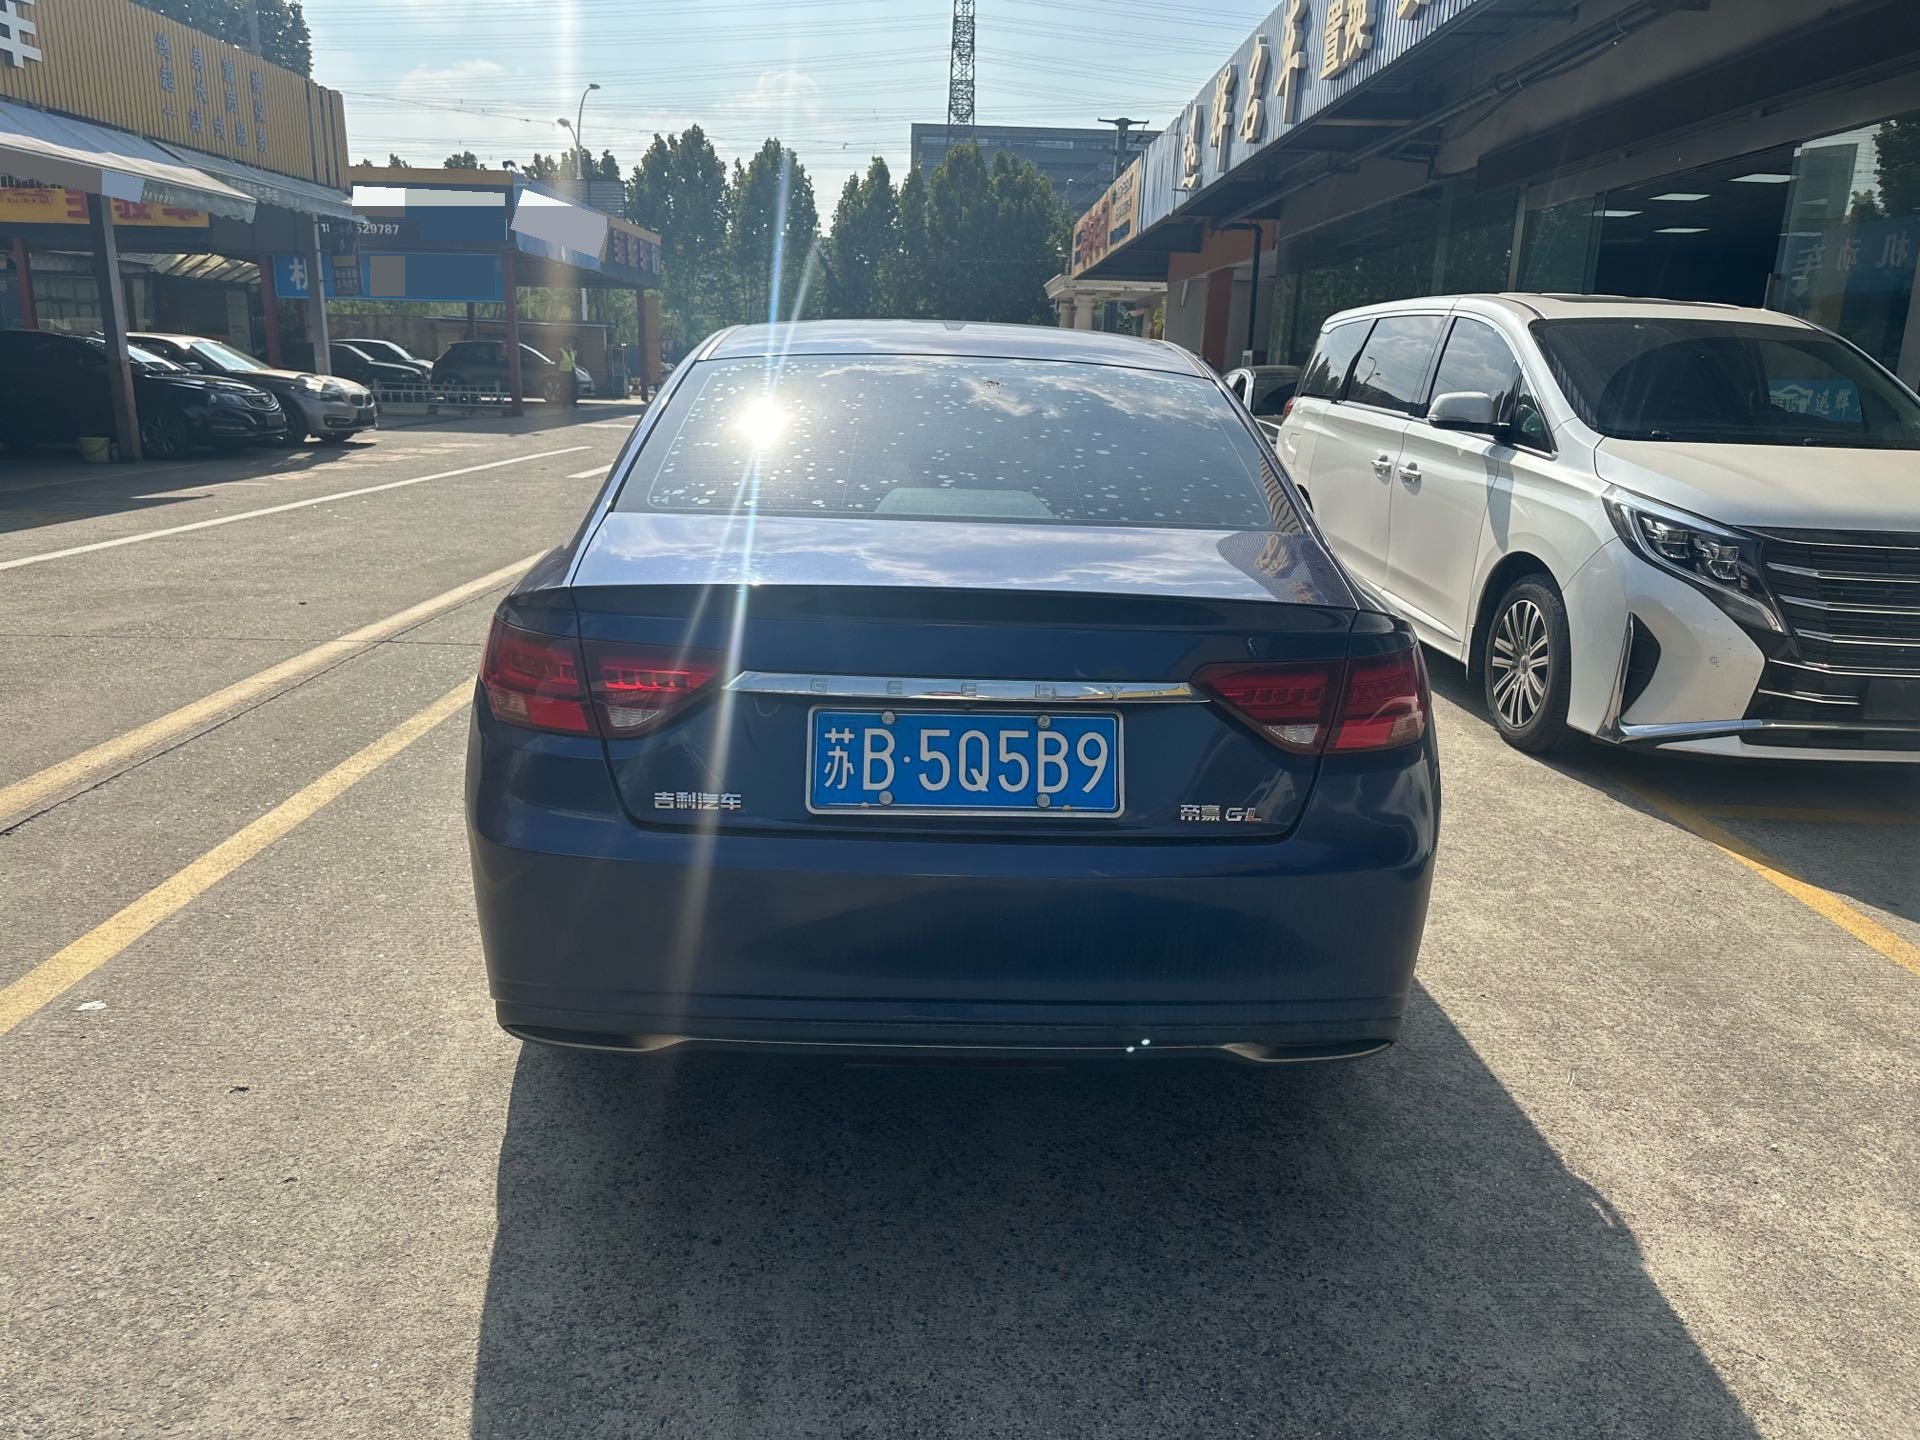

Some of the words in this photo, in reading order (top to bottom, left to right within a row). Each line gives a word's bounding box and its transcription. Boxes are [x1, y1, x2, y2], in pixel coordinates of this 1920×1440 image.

[810, 678, 1125, 700] GEELY
[823, 727, 1108, 794] 苏B·5Q5B9
[654, 791, 742, 811] 吉利汽车
[1180, 804, 1220, 821] 帝豪
[1225, 807, 1262, 821] GL
